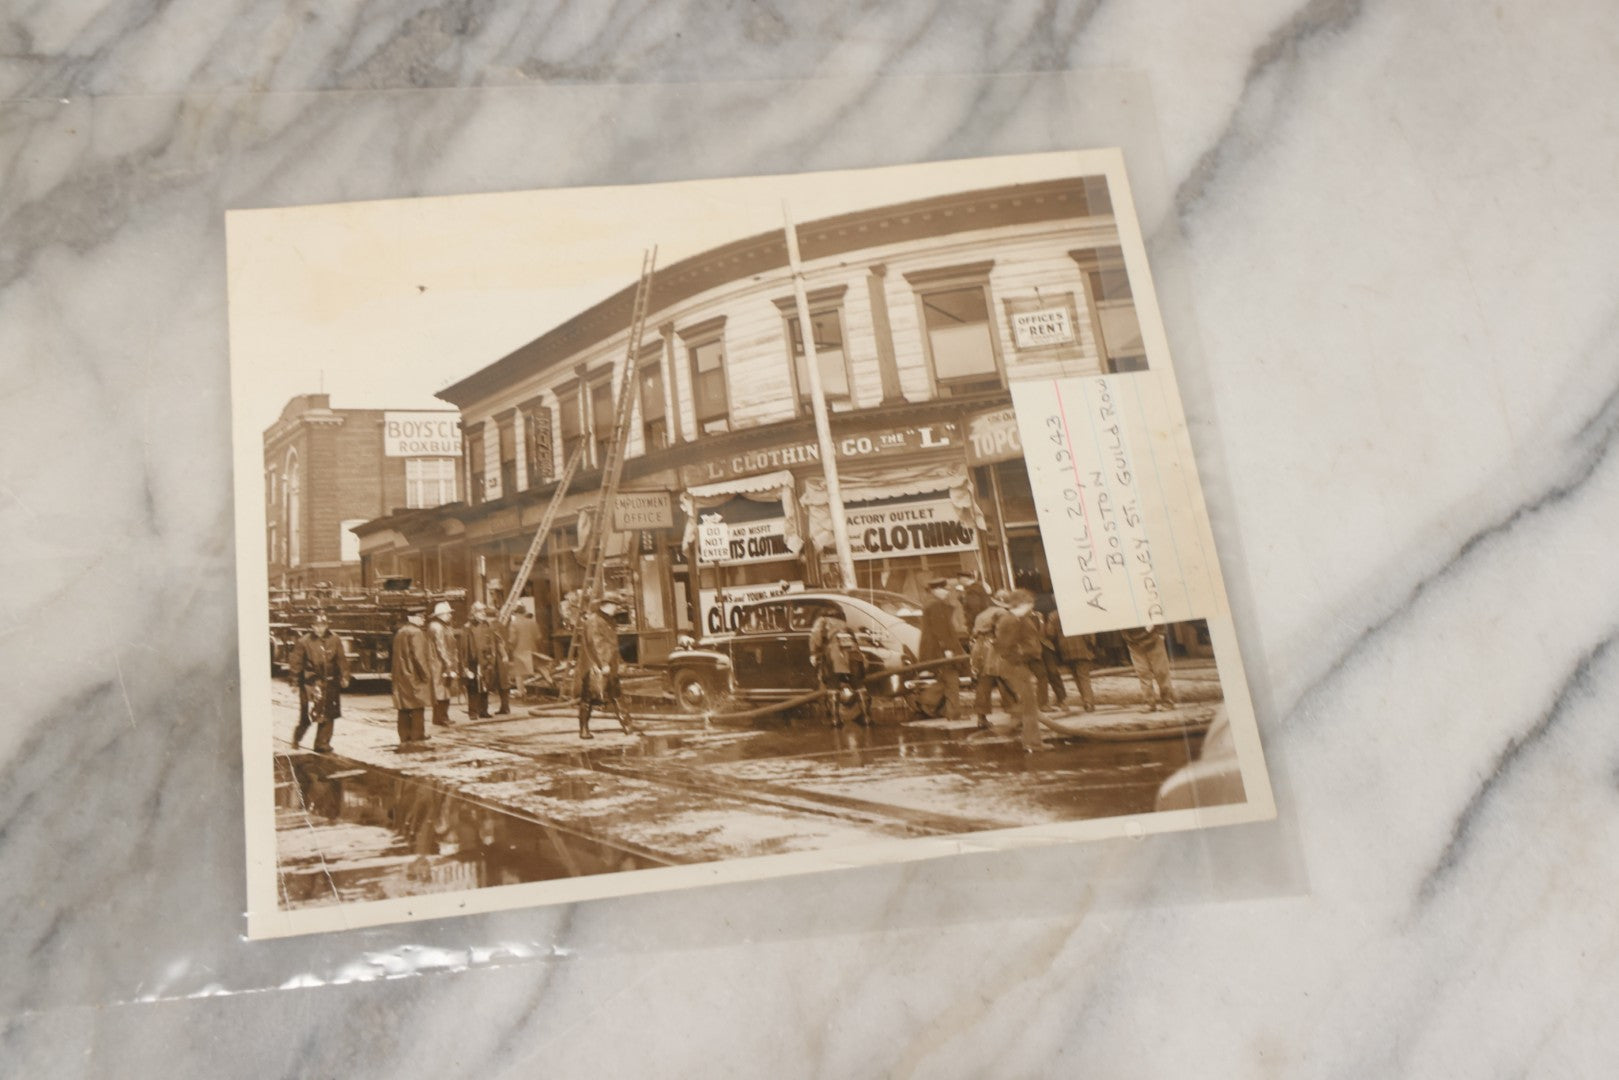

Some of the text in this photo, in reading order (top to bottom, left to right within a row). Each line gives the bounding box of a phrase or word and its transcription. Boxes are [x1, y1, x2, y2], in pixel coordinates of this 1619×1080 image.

[1018, 313, 1064, 325] OFFICES
[1029, 321, 1064, 336] RENT
[731, 443, 836, 474] CLOTHIN
[841, 437, 880, 456] CO.
[880, 432, 904, 447] THE
[615, 496, 668, 511] EMPLOYMENT
[623, 511, 663, 524] OFFICE
[846, 508, 934, 526] ACTORY OUTLET
[1046, 415, 1108, 612] APRIL 20, 1943
[1122, 499, 1140, 528] ST.
[1089, 471, 1125, 574] BOSTON
[733, 528, 746, 537] AND
[705, 538, 723, 547] NOT
[703, 548, 729, 558] ENTER
[1133, 537, 1164, 620] DUDLEY
